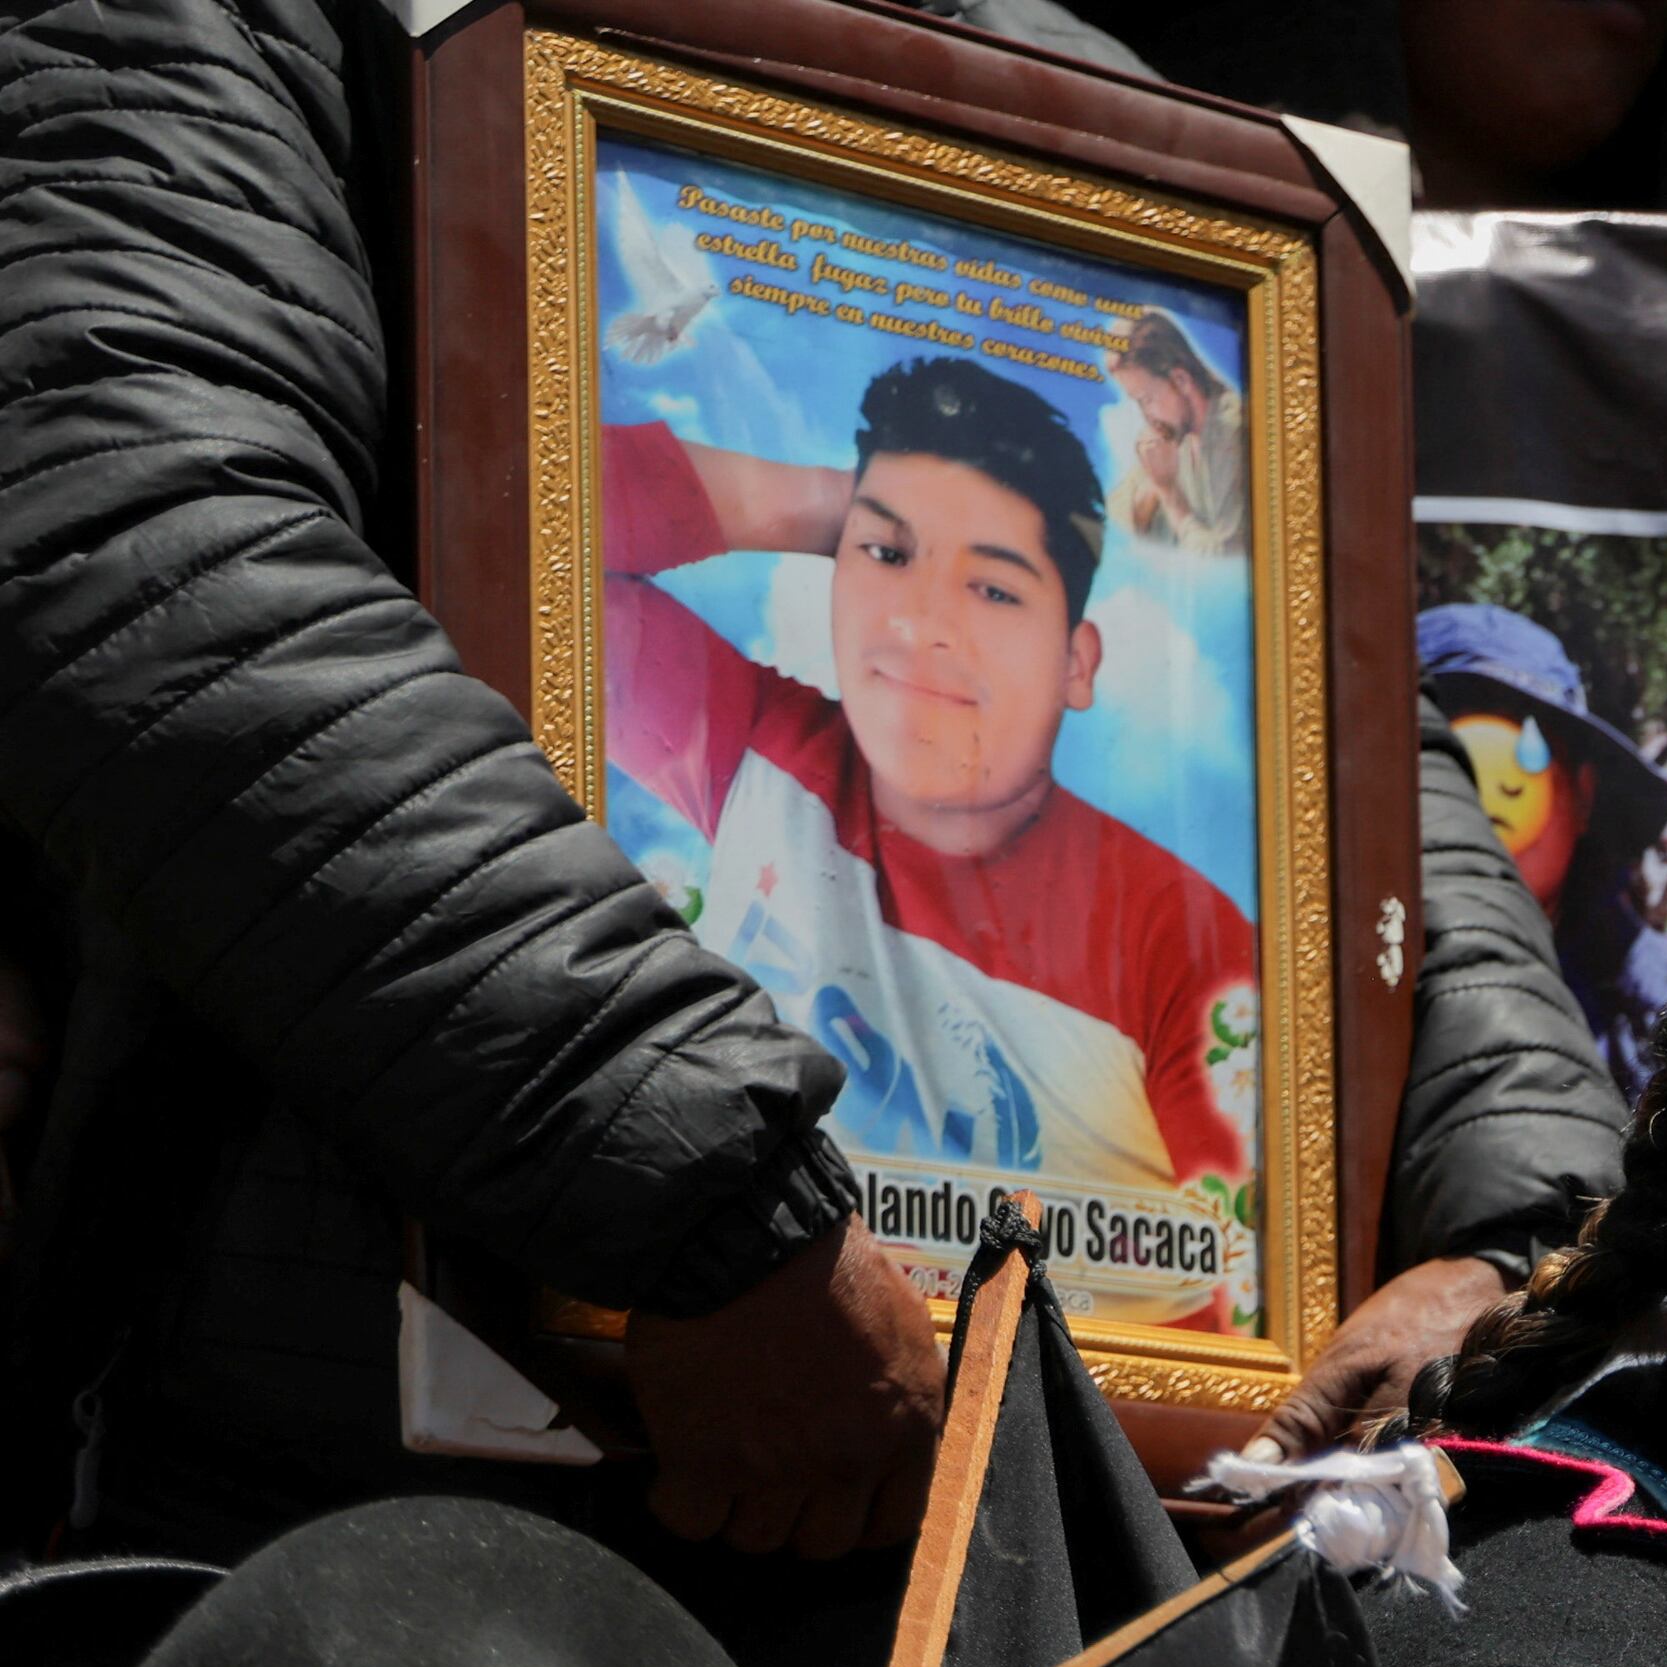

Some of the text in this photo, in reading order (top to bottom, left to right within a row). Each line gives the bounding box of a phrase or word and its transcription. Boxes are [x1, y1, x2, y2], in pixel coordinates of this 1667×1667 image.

[678, 185, 1143, 320] Pasaste por nuestras vidas como una
[695, 232, 797, 271] estrella
[811, 252, 888, 293] fugaz
[895, 281, 949, 308] pero
[956, 291, 983, 316] tu
[989, 297, 1054, 333] brillo
[729, 275, 829, 315] siempre
[835, 303, 864, 325] en
[870, 312, 974, 349] nuestros
[1086, 1200, 1218, 1275] Sacaca
